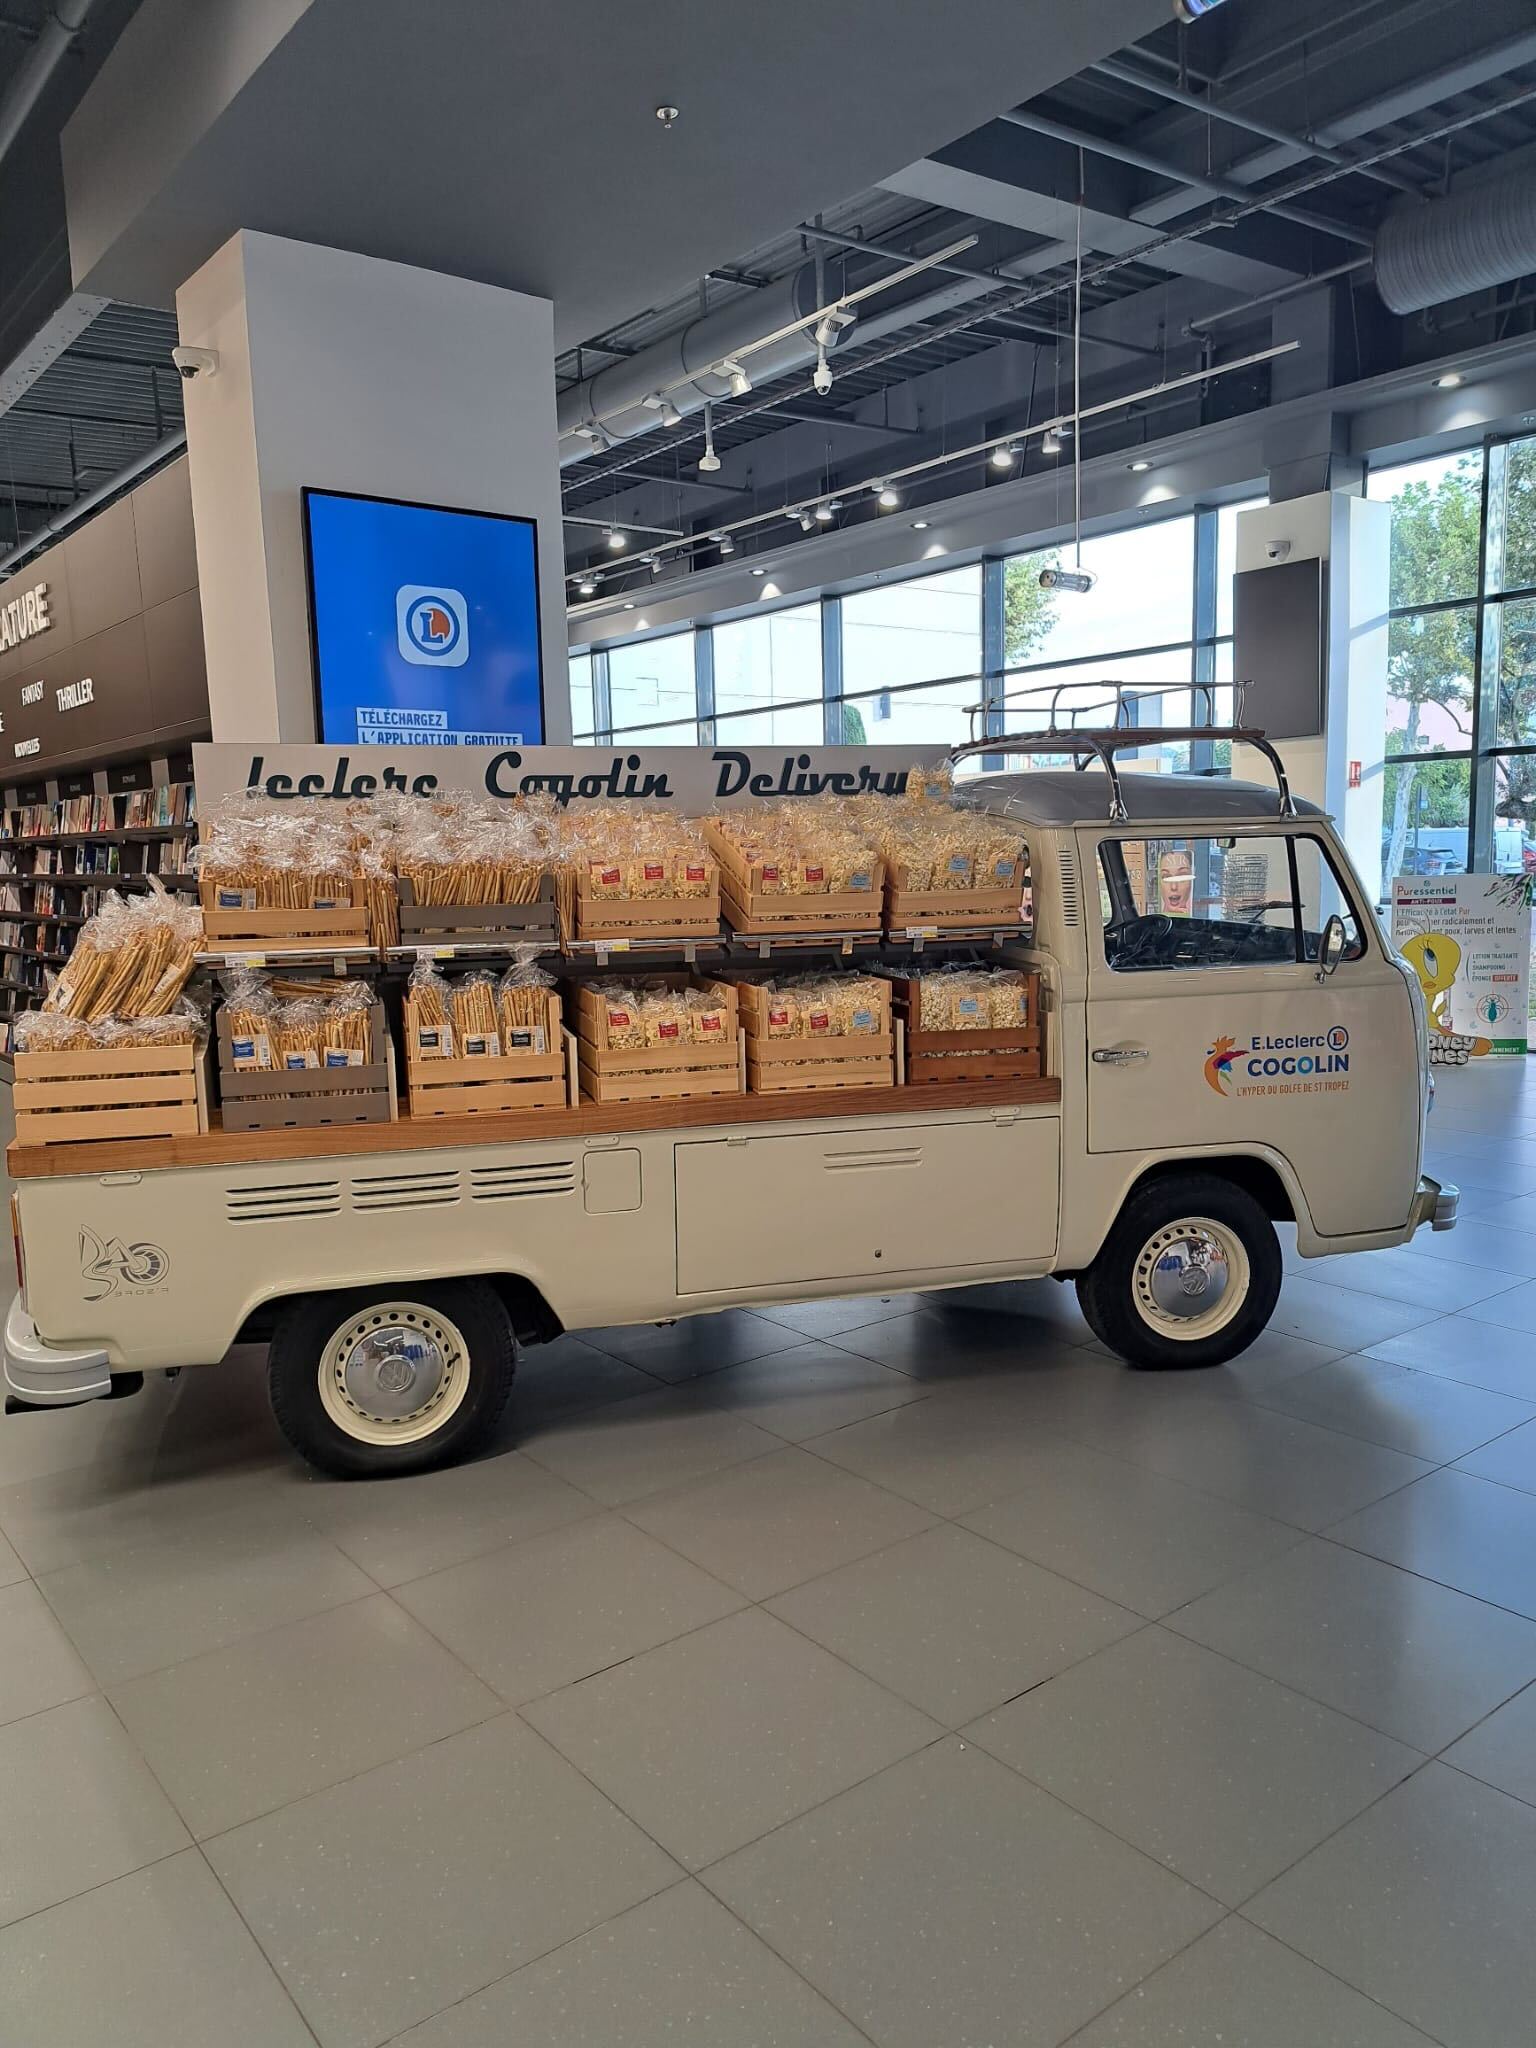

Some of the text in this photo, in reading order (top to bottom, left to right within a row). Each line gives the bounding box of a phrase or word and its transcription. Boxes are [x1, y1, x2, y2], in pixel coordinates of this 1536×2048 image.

[21, 680, 44, 706] FANTASY
[56, 678, 94, 712] THRILLER
[360, 708, 442, 727] TÉLÉCHARGEZ
[361, 732, 458, 746] L'APPLICATION
[485, 751, 673, 808] Cogolin
[1397, 884, 1457, 896] Puressentiel
[1458, 907, 1470, 915] Pur
[1441, 917, 1485, 926] radicalement
[1464, 926, 1485, 934] larves
[1487, 926, 1494, 934] et
[1496, 925, 1516, 934] lentes
[1252, 1034, 1325, 1050] E.Leclerc
[1248, 1054, 1349, 1076] COGOLIN
[1236, 1085, 1265, 1097] L'HYPER
[1279, 1083, 1302, 1094] GOLFE
[1303, 1082, 1312, 1093] DE
[1315, 1081, 1323, 1092] ST
[1324, 1080, 1349, 1091] TROPEZ
